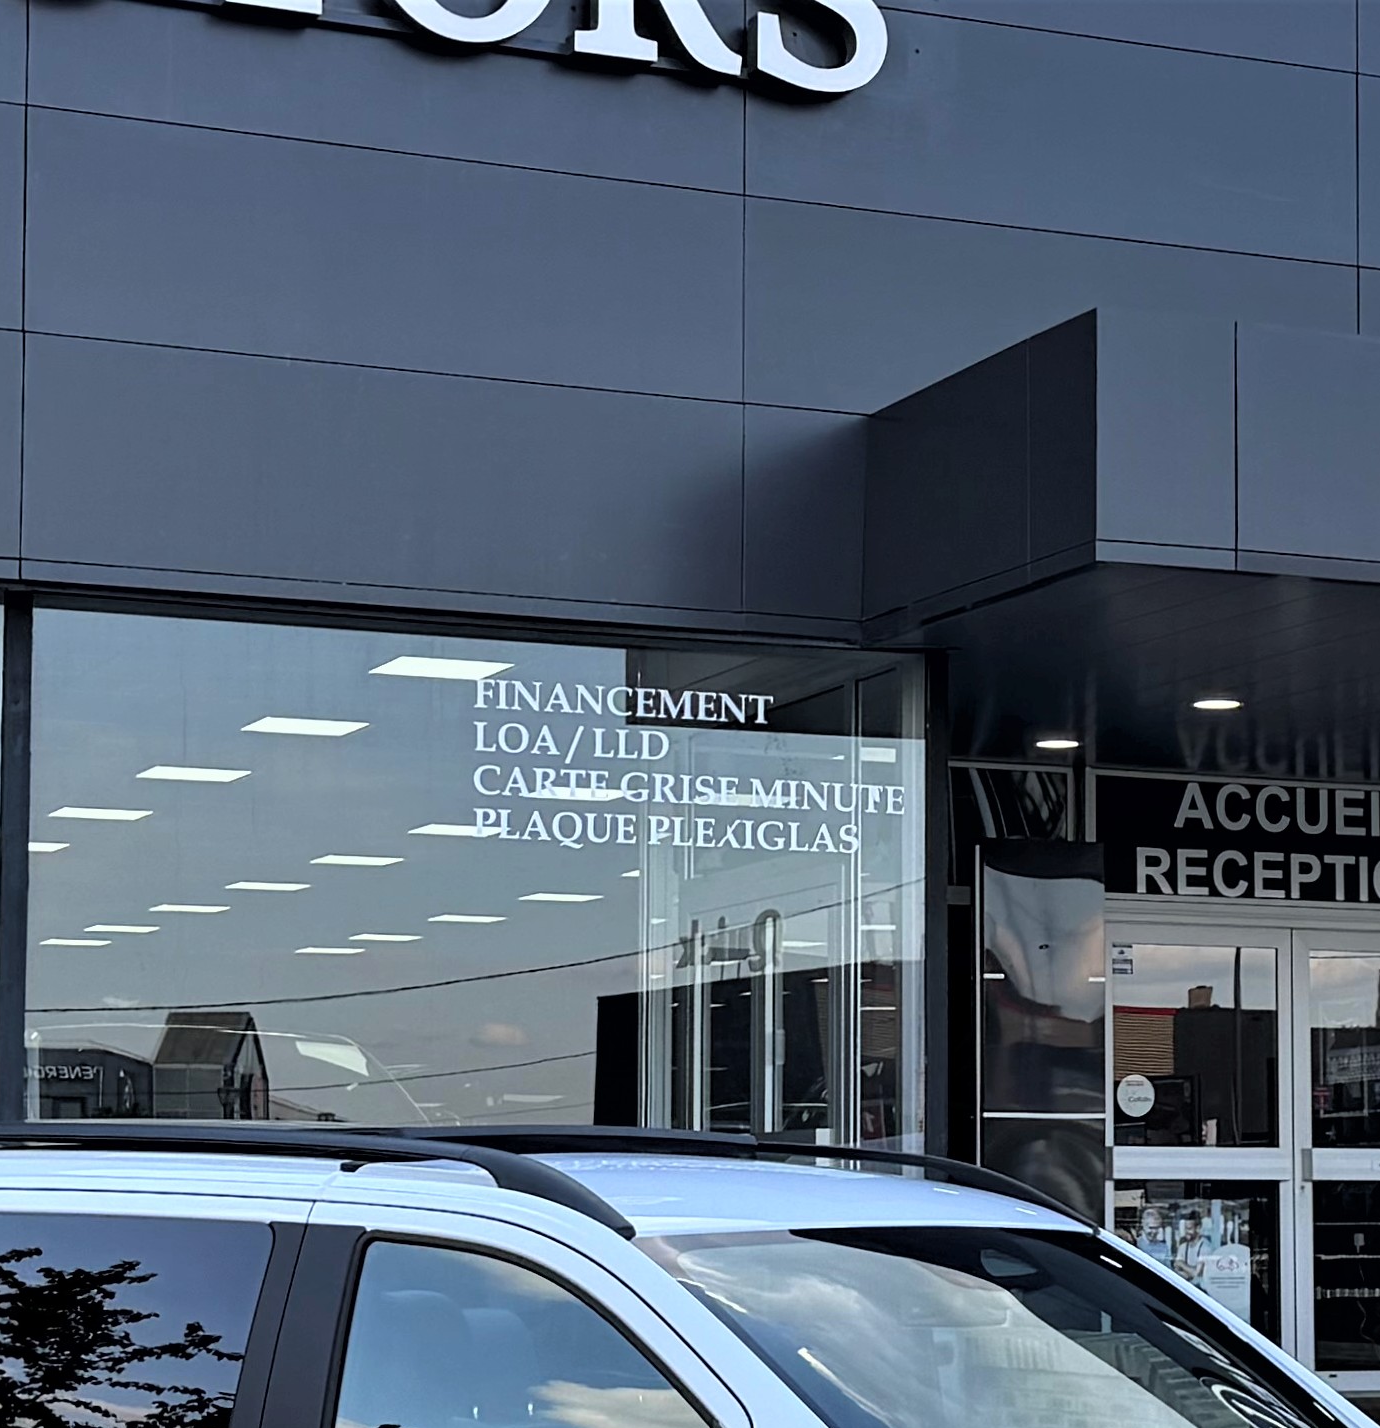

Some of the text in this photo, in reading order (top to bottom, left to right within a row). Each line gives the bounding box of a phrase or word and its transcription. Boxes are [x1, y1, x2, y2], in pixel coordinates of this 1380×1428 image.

[473, 678, 774, 726] FINANCEMENT
[473, 764, 906, 816] CARTE GRISE MINUTE
[473, 807, 862, 855] PLAQUE PLEXIGLAS
